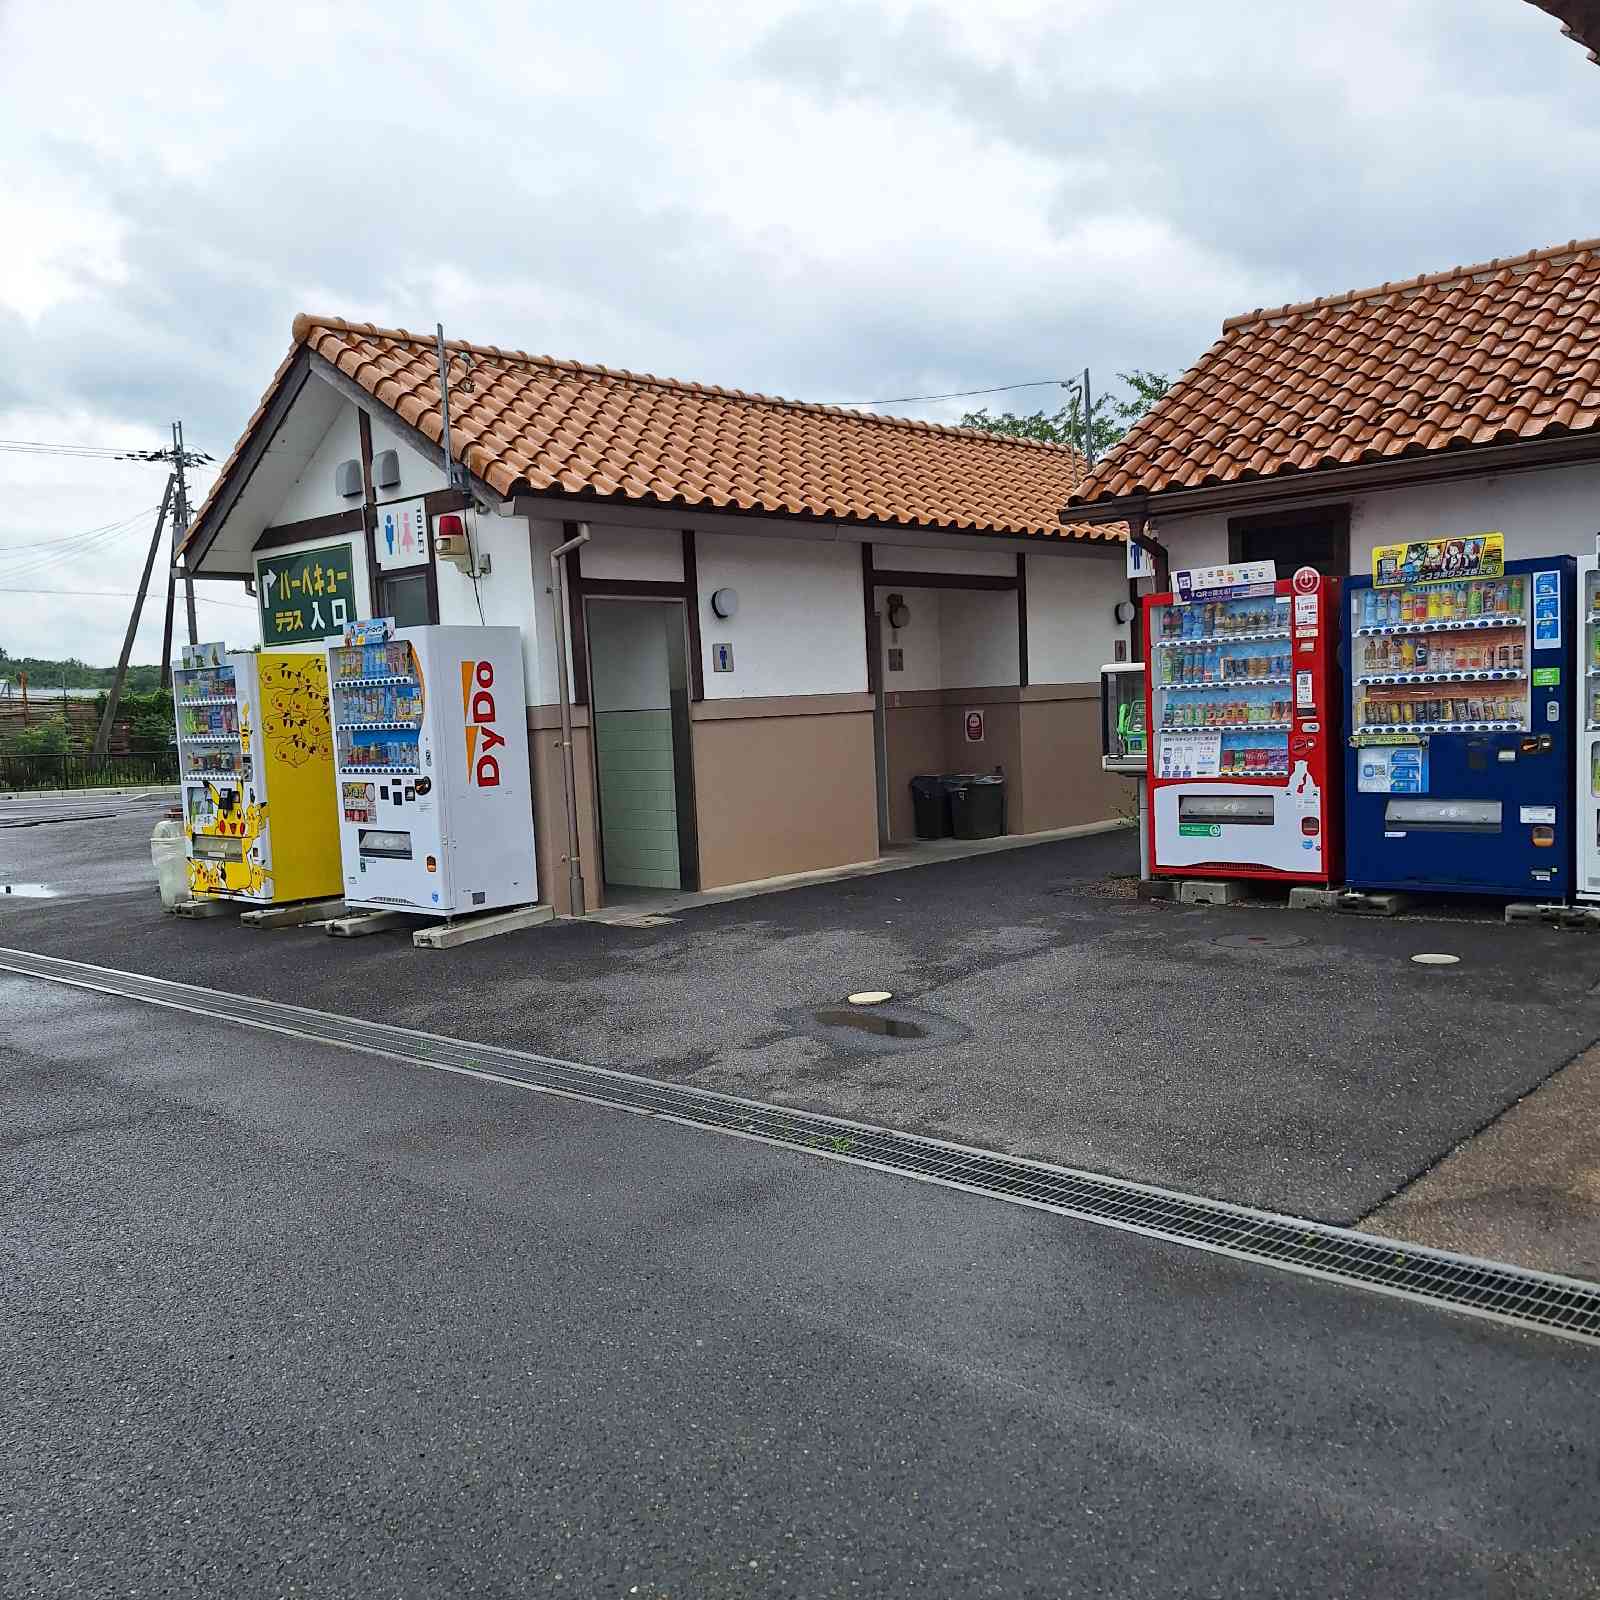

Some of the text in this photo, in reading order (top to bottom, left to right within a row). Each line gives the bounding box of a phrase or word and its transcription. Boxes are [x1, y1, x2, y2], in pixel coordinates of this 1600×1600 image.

[416, 503, 425, 554] TOILET
[275, 610, 304, 632] テラス
[311, 598, 348, 631] 入口
